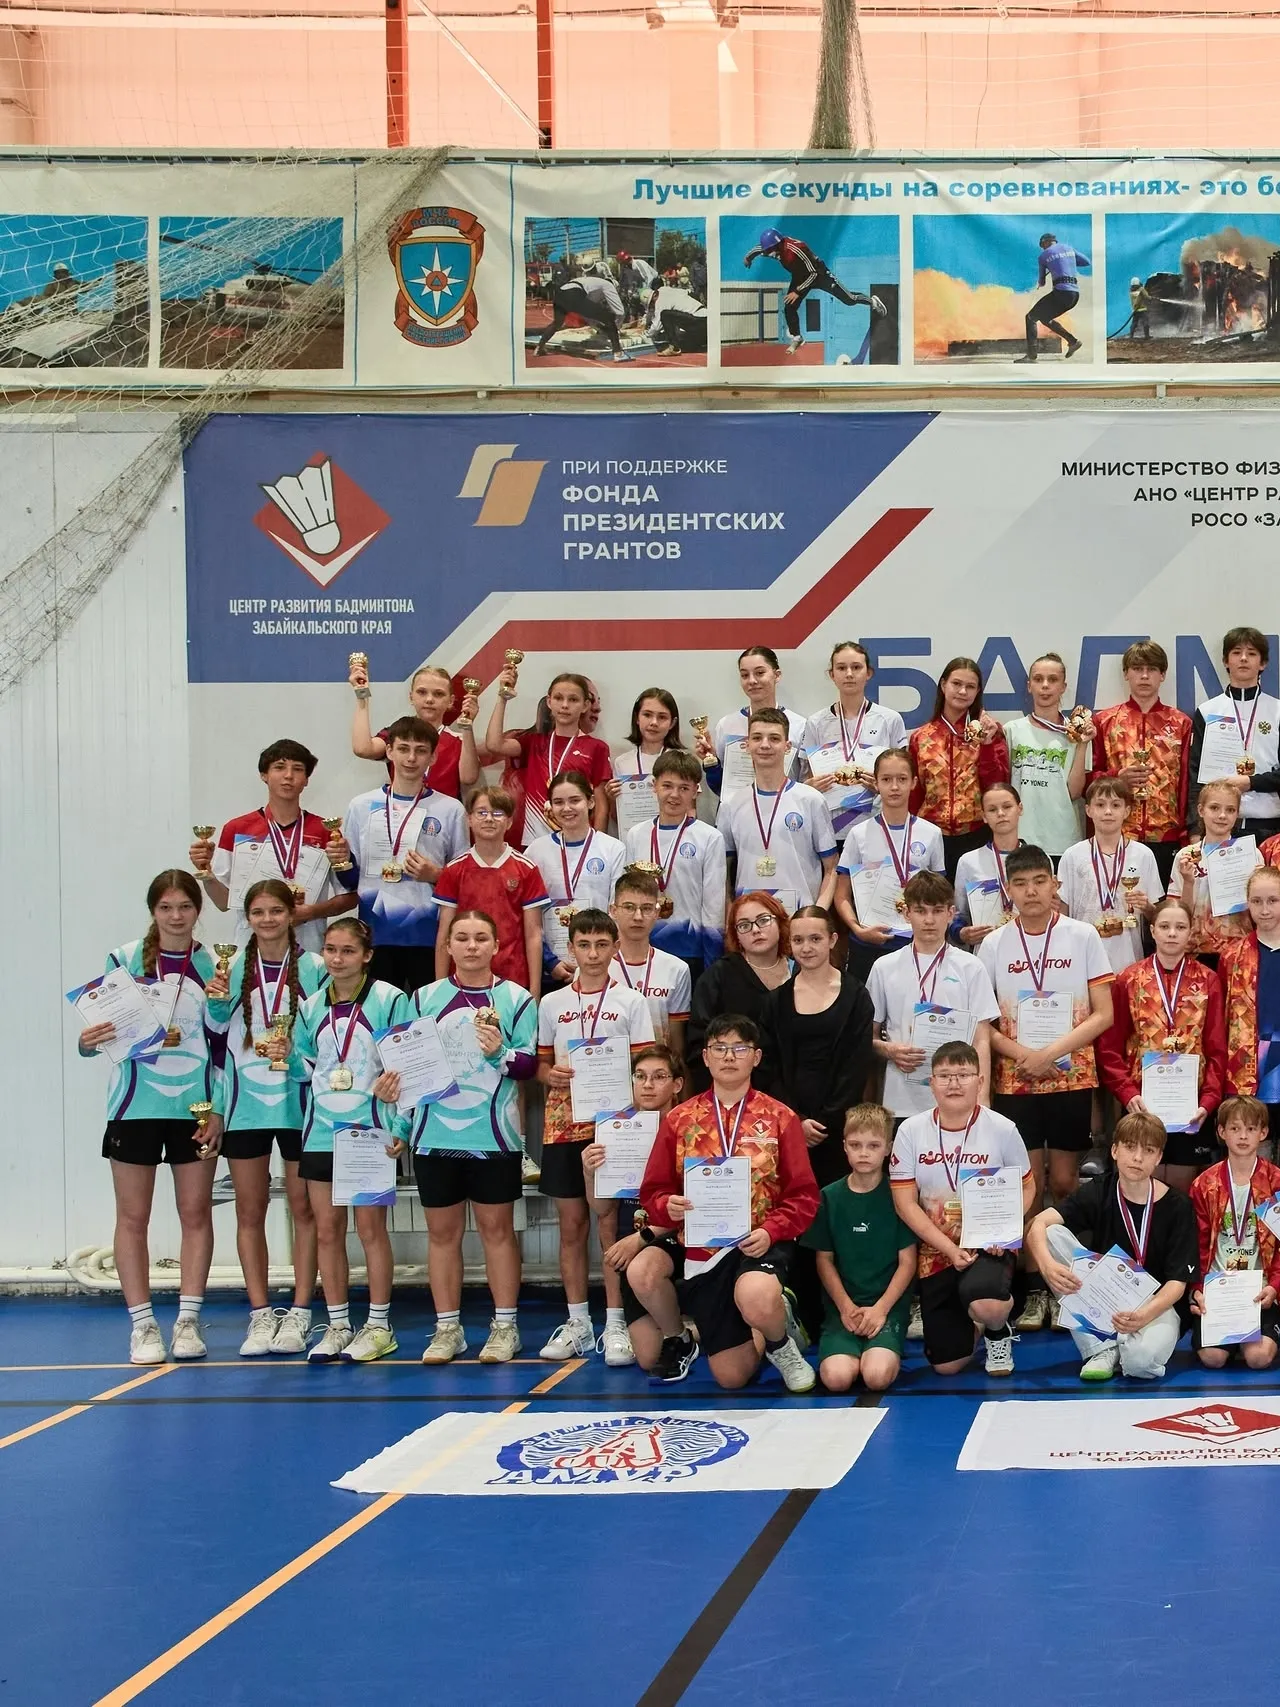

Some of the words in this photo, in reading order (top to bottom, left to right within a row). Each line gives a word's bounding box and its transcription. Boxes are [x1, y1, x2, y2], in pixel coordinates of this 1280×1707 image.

[634, 178, 752, 204] Лучшие
[761, 182, 892, 202] секунды
[903, 182, 938, 198] на
[949, 180, 1189, 202] соревнованиях-
[1200, 180, 1248, 196] это
[422, 207, 449, 217] МЧС
[562, 460, 600, 474] ПРИ
[606, 459, 728, 476] ПОДДЕРЖКЕ
[1061, 461, 1229, 476] МИНИСТЕРСТВО
[562, 484, 660, 504] ФОНДА
[1133, 487, 1178, 502] АНО
[1183, 486, 1259, 504] «ЦЕНТР
[563, 512, 785, 534] ПРЕЗИДЕНТСКИХ
[1191, 512, 1248, 527] РОСО
[564, 541, 682, 560] ГРАНТОВ
[229, 600, 267, 617] ЦЕНТР
[270, 599, 332, 615] РАЗВИТИЯ
[335, 598, 415, 616] БАДМИНТОНА
[252, 616, 358, 635] ЗАБАЙКАЛЬСКОГО
[361, 619, 391, 634] КРАЯ
[1030, 780, 1049, 788] YONEX
[1050, 1450, 1119, 1458] ЦЕНТР
[1126, 1447, 1236, 1456] РАЗВИТИЯ
